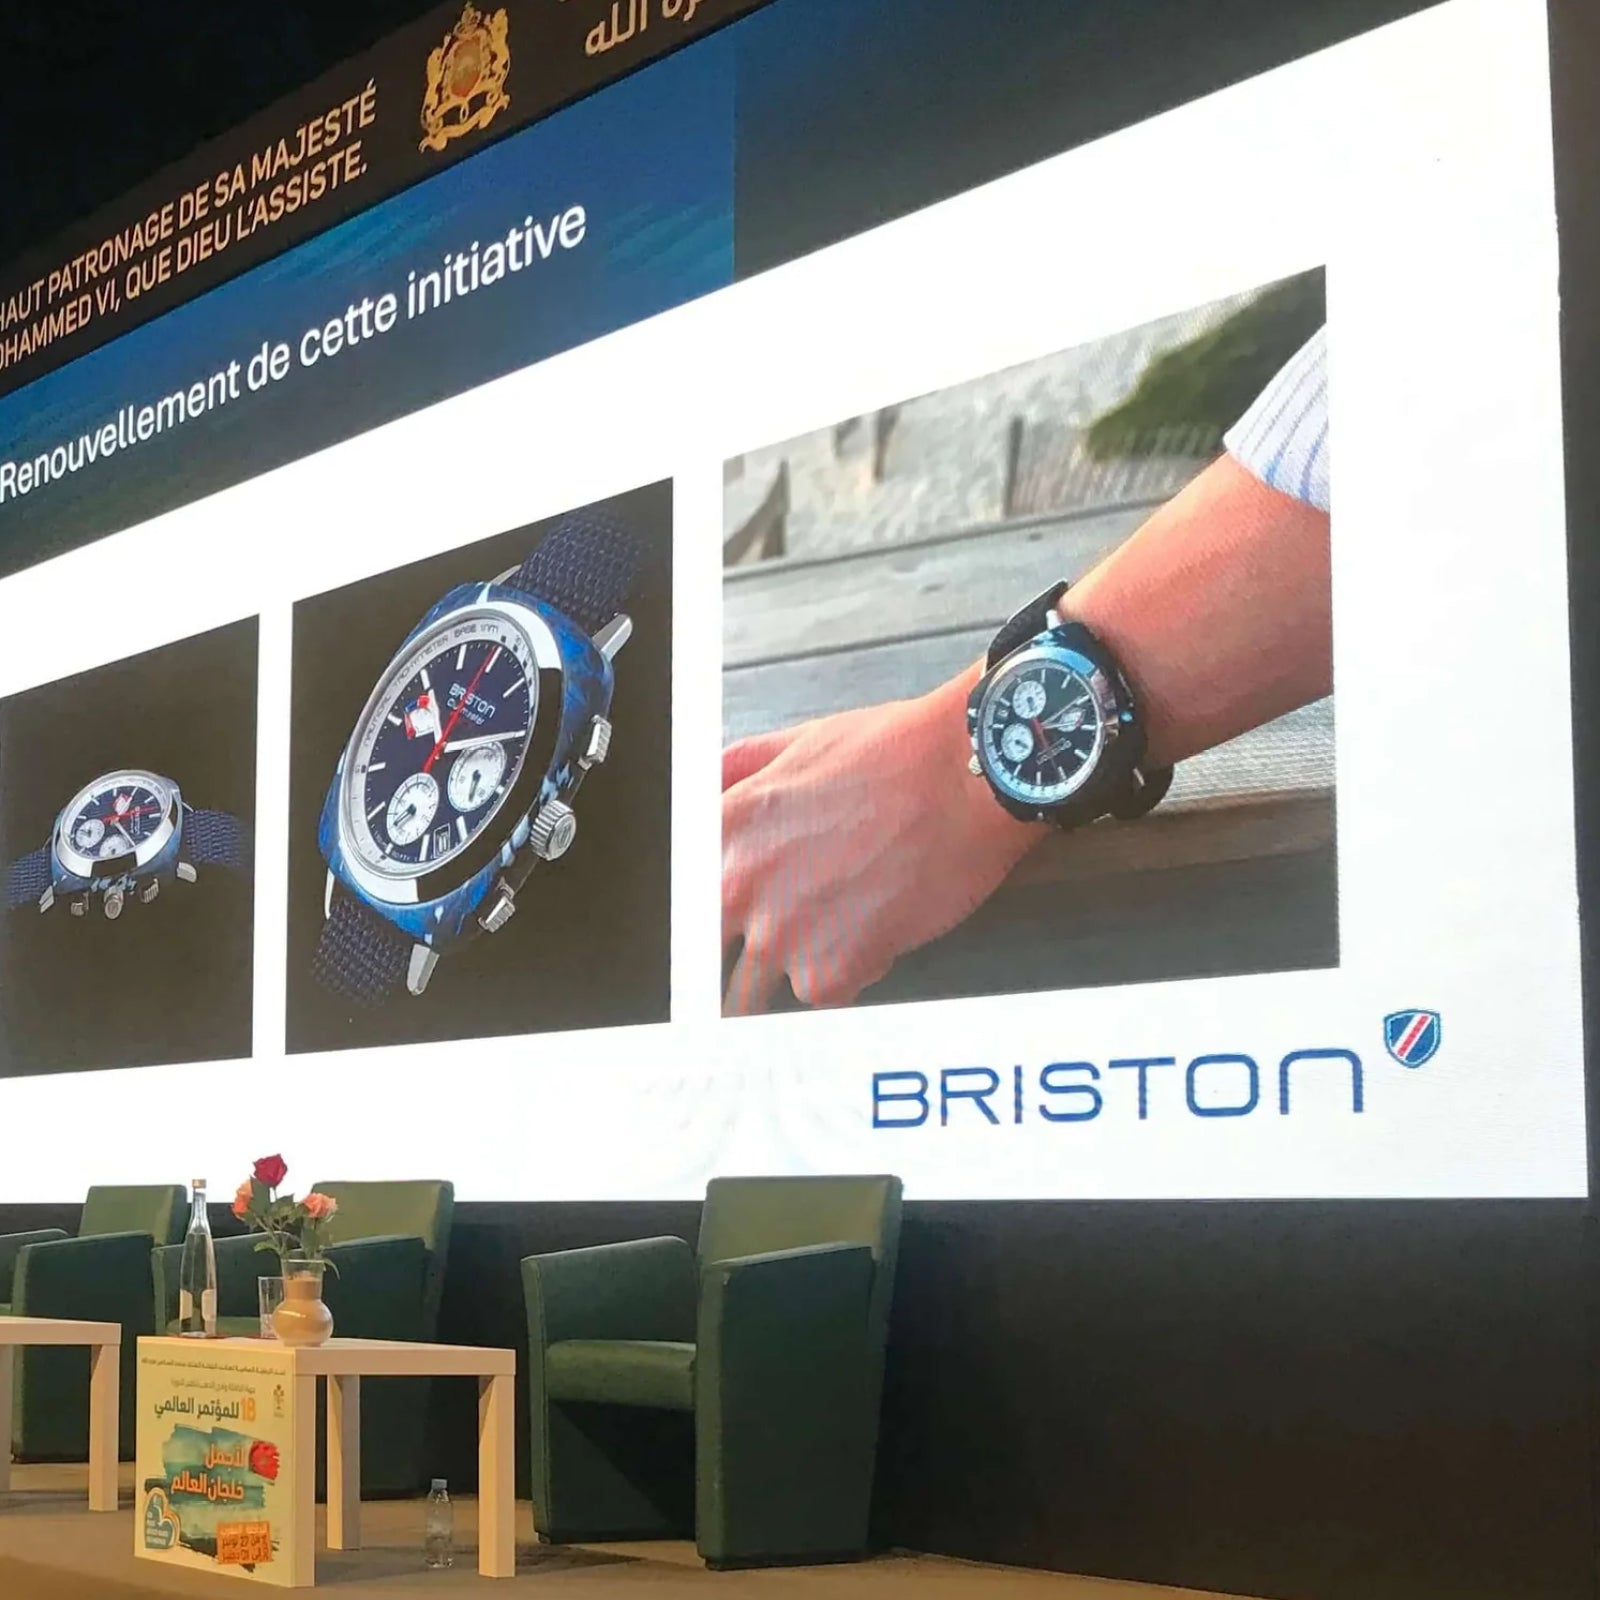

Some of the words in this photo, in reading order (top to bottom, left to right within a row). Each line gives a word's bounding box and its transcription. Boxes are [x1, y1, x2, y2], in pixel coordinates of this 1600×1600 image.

[48, 202, 174, 304] PATRONAGE
[179, 181, 210, 230] DE
[214, 163, 246, 208] SA
[251, 77, 377, 188] MAJESTÉ
[96, 278, 121, 317] VI,
[125, 246, 172, 300] QUE
[177, 213, 231, 274] DIEU
[237, 140, 368, 241] L'ASSISTE.
[0, 360, 241, 503] Renouvellement
[247, 340, 291, 391] de
[300, 286, 397, 367] cette
[406, 203, 587, 320] initiative
[872, 1047, 1364, 1129] BRISTON
[154, 1395, 195, 1420] العالمي
[241, 1397, 256, 1422] 18
